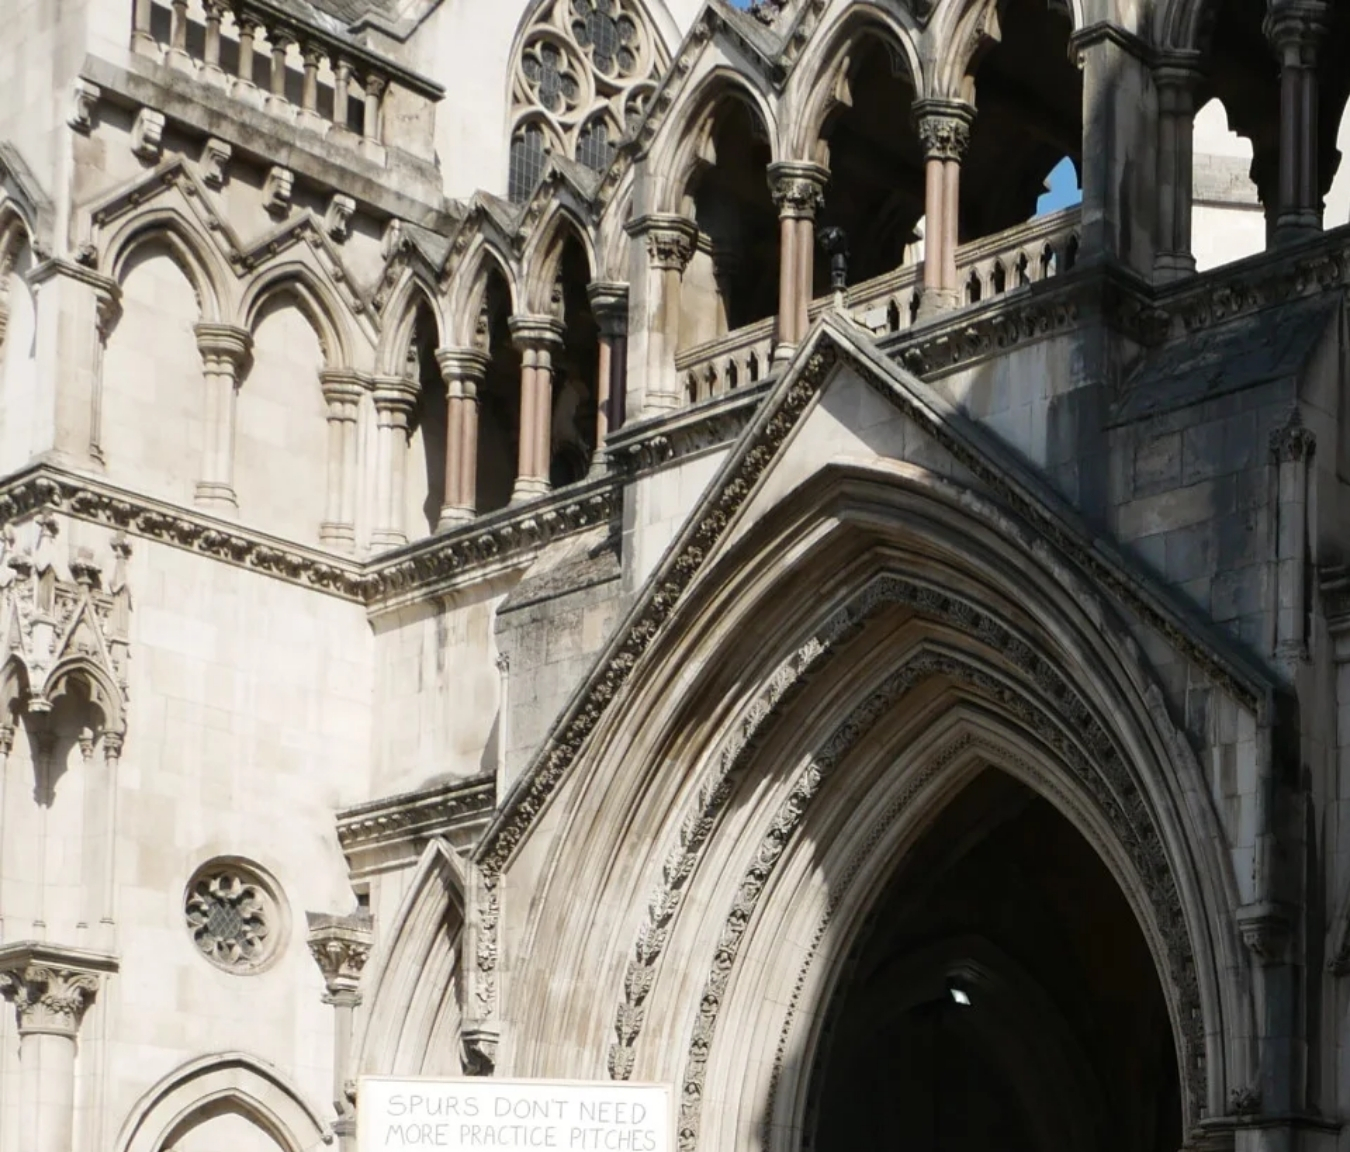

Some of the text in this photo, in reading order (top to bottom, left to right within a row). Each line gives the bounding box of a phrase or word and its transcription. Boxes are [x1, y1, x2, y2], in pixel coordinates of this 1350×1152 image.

[387, 1095, 646, 1124] SPURS DON'T NEED
[385, 1124, 656, 1151] MORE PRACTICE PITCHES
